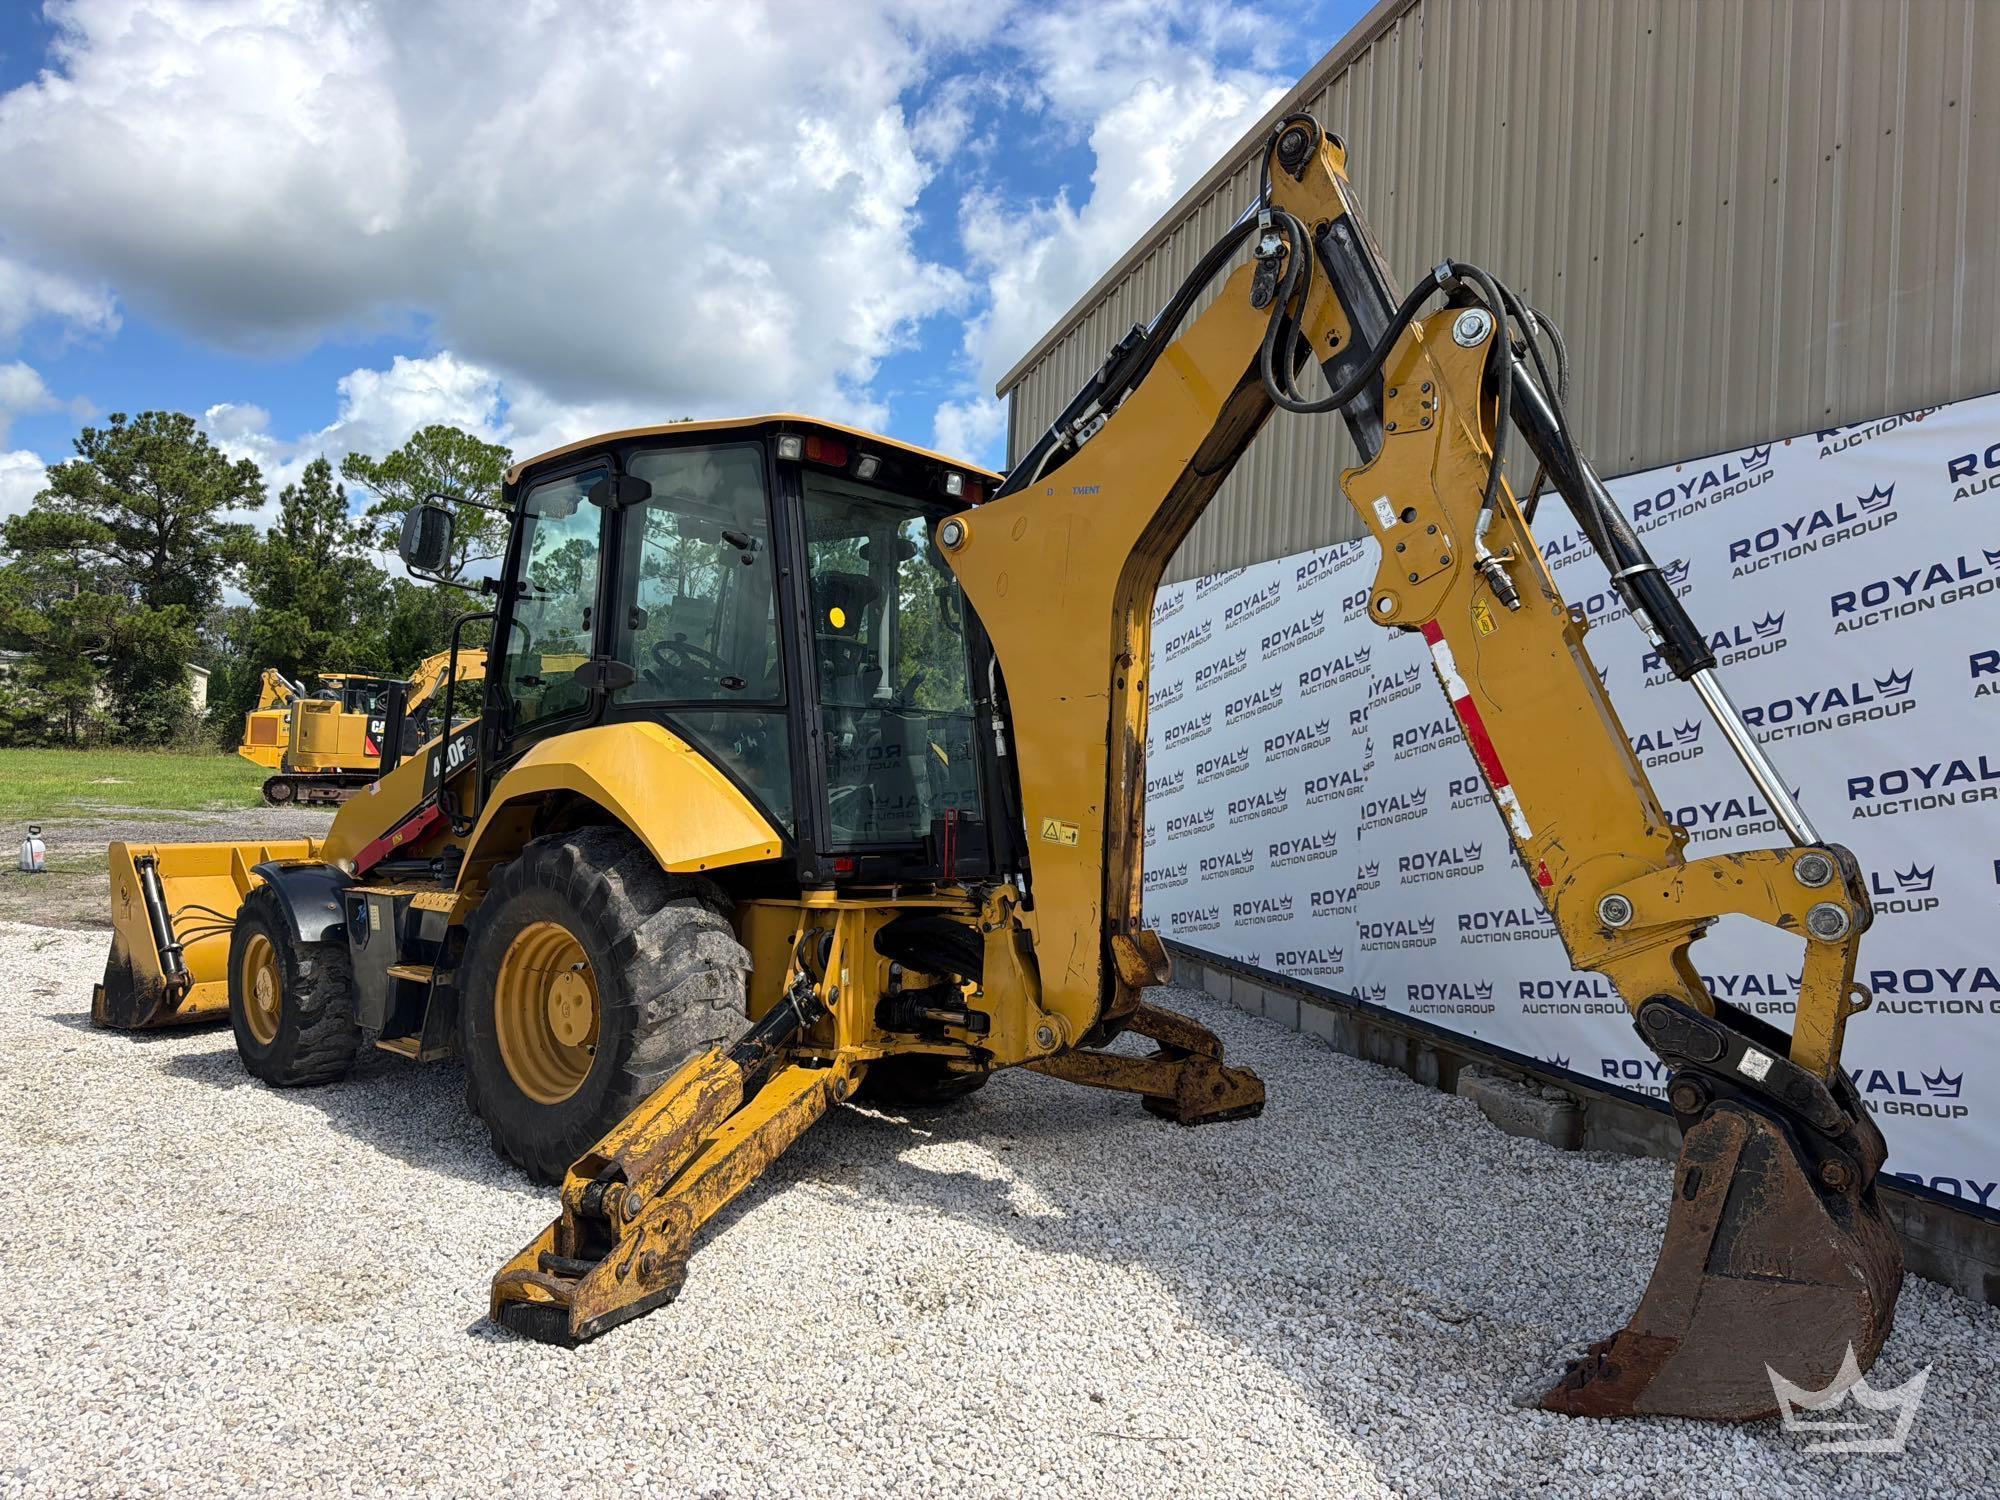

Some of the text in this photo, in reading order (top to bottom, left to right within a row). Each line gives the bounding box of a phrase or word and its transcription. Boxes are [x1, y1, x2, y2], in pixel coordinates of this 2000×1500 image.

[1819, 412, 1915, 459] AUCTION
[1633, 463, 1740, 522] ROYAL
[1635, 469, 1774, 535] AUCTION GROUP
[1729, 502, 1857, 563] ROYAL
[1732, 511, 1898, 579] AUCTION GROUP
[1296, 544, 1349, 582] ROYAL
[1554, 545, 1595, 571] GROU
[1195, 568, 1234, 593] ROY
[1297, 551, 1364, 592] AUCTION GROUP
[1196, 581, 1223, 601] AUCTION
[1831, 556, 1983, 617] ROYAL
[1152, 598, 1175, 620] YAL
[1224, 589, 1267, 622] ROYAL
[1225, 596, 1281, 631] AUCTION GROUP
[1344, 606, 1367, 624] AUCT
[1567, 590, 1621, 618] ROY
[1834, 577, 2000, 635] AUCTION GRO
[1152, 604, 1184, 628] TION GROUP
[1589, 608, 1632, 629] CTION
[1165, 626, 1201, 654] ROYAL
[1261, 619, 1311, 651] ROYAL
[1262, 627, 1325, 661] AUCTION GROUP
[1166, 633, 1212, 662] AUCTION GROUP
[1722, 639, 1787, 666] GROUP
[1195, 656, 1235, 683] ROYAL
[1195, 663, 1247, 692] AUCTION GROUP
[1299, 655, 1354, 687] ROYAL
[1149, 685, 1174, 706] OYAL
[1300, 678, 1338, 697] AUCTION
[1369, 673, 1404, 698] YAL
[1369, 683, 1422, 710] TION GROUP
[1165, 693, 1184, 707] GROUP
[1225, 690, 1269, 717] ROYAL
[1742, 682, 1874, 728] ROYAL
[1225, 698, 1283, 726] AUCTION GROUP
[1757, 700, 1916, 743] UCTION GROUP
[371, 720, 385, 733] CA
[1165, 718, 1201, 742] ROYAL
[1393, 717, 1456, 749] ROYAL
[1165, 727, 1212, 750] AUCTION GROUP
[1264, 726, 1315, 753] ROYAL
[1265, 736, 1331, 763] AUCTION GROUP
[1394, 734, 1466, 761] AUCTION GROU
[433, 735, 476, 777] 40F2
[1196, 752, 1237, 776] ROYAL
[1646, 746, 1704, 768] GROUP
[1146, 774, 1174, 793] OYAL
[1197, 763, 1249, 785] AUCTION GROUP
[1305, 769, 1363, 795] ROYAL
[1847, 755, 2000, 801] ROYAL
[1165, 785, 1184, 797] GROUP
[1306, 790, 1345, 806] AUCTION
[1451, 793, 1492, 810] AUCTIO
[1228, 792, 1274, 815] ROYAL
[1229, 804, 1288, 825] AUCTION GROUP
[1361, 794, 1410, 819] OYAL
[1852, 792, 1955, 819] AUCTION
[1167, 812, 1204, 832] ROYAL
[1361, 808, 1428, 831] UCTION GROUP
[1167, 823, 1215, 841] AUCTION GROUP
[1691, 827, 1732, 842] TION
[1269, 836, 1321, 857] ROYAL
[1200, 852, 1241, 872] ROYAL
[1270, 849, 1338, 868] AUCTION GROUP
[1399, 848, 1463, 872] ROYAL
[1144, 865, 1178, 884] ROYAL
[1201, 865, 1254, 881] AUCTION GROUP
[1400, 864, 1484, 885] AUCTION GROUP
[1145, 878, 1188, 892] AUCTION GROUP
[1356, 880, 1380, 891] ROUP
[1233, 899, 1279, 916] ROYAL
[1310, 887, 1357, 906] ROYA
[1874, 897, 1939, 914] ROUP
[1171, 909, 1209, 925] ROYAL
[1234, 913, 1294, 926] AUCTION GROUP
[1312, 905, 1351, 918] AUCTION
[1458, 908, 1534, 931] ROYAL
[1173, 922, 1220, 934] AUCTION GROUP
[1359, 920, 1418, 940] ROYAL
[1460, 928, 1558, 945] AUCTION GROUP
[1361, 937, 1437, 951] AUCTION GROUP
[1276, 950, 1327, 966] ROYAL
[1314, 966, 1344, 975] GROUP
[1870, 967, 2000, 993] ROYA
[1407, 984, 1474, 1000] ROYAL
[1519, 979, 1608, 999] ROYAL
[1409, 1004, 1495, 1014] AUCTION GROUP
[1522, 1003, 1630, 1014] AUCTION GROU
[1756, 1002, 1796, 1014] GRO
[1876, 1000, 1984, 1014] AUCTION
[1601, 1059, 1674, 1080] ROY
[1883, 1101, 1968, 1119] GROUP
